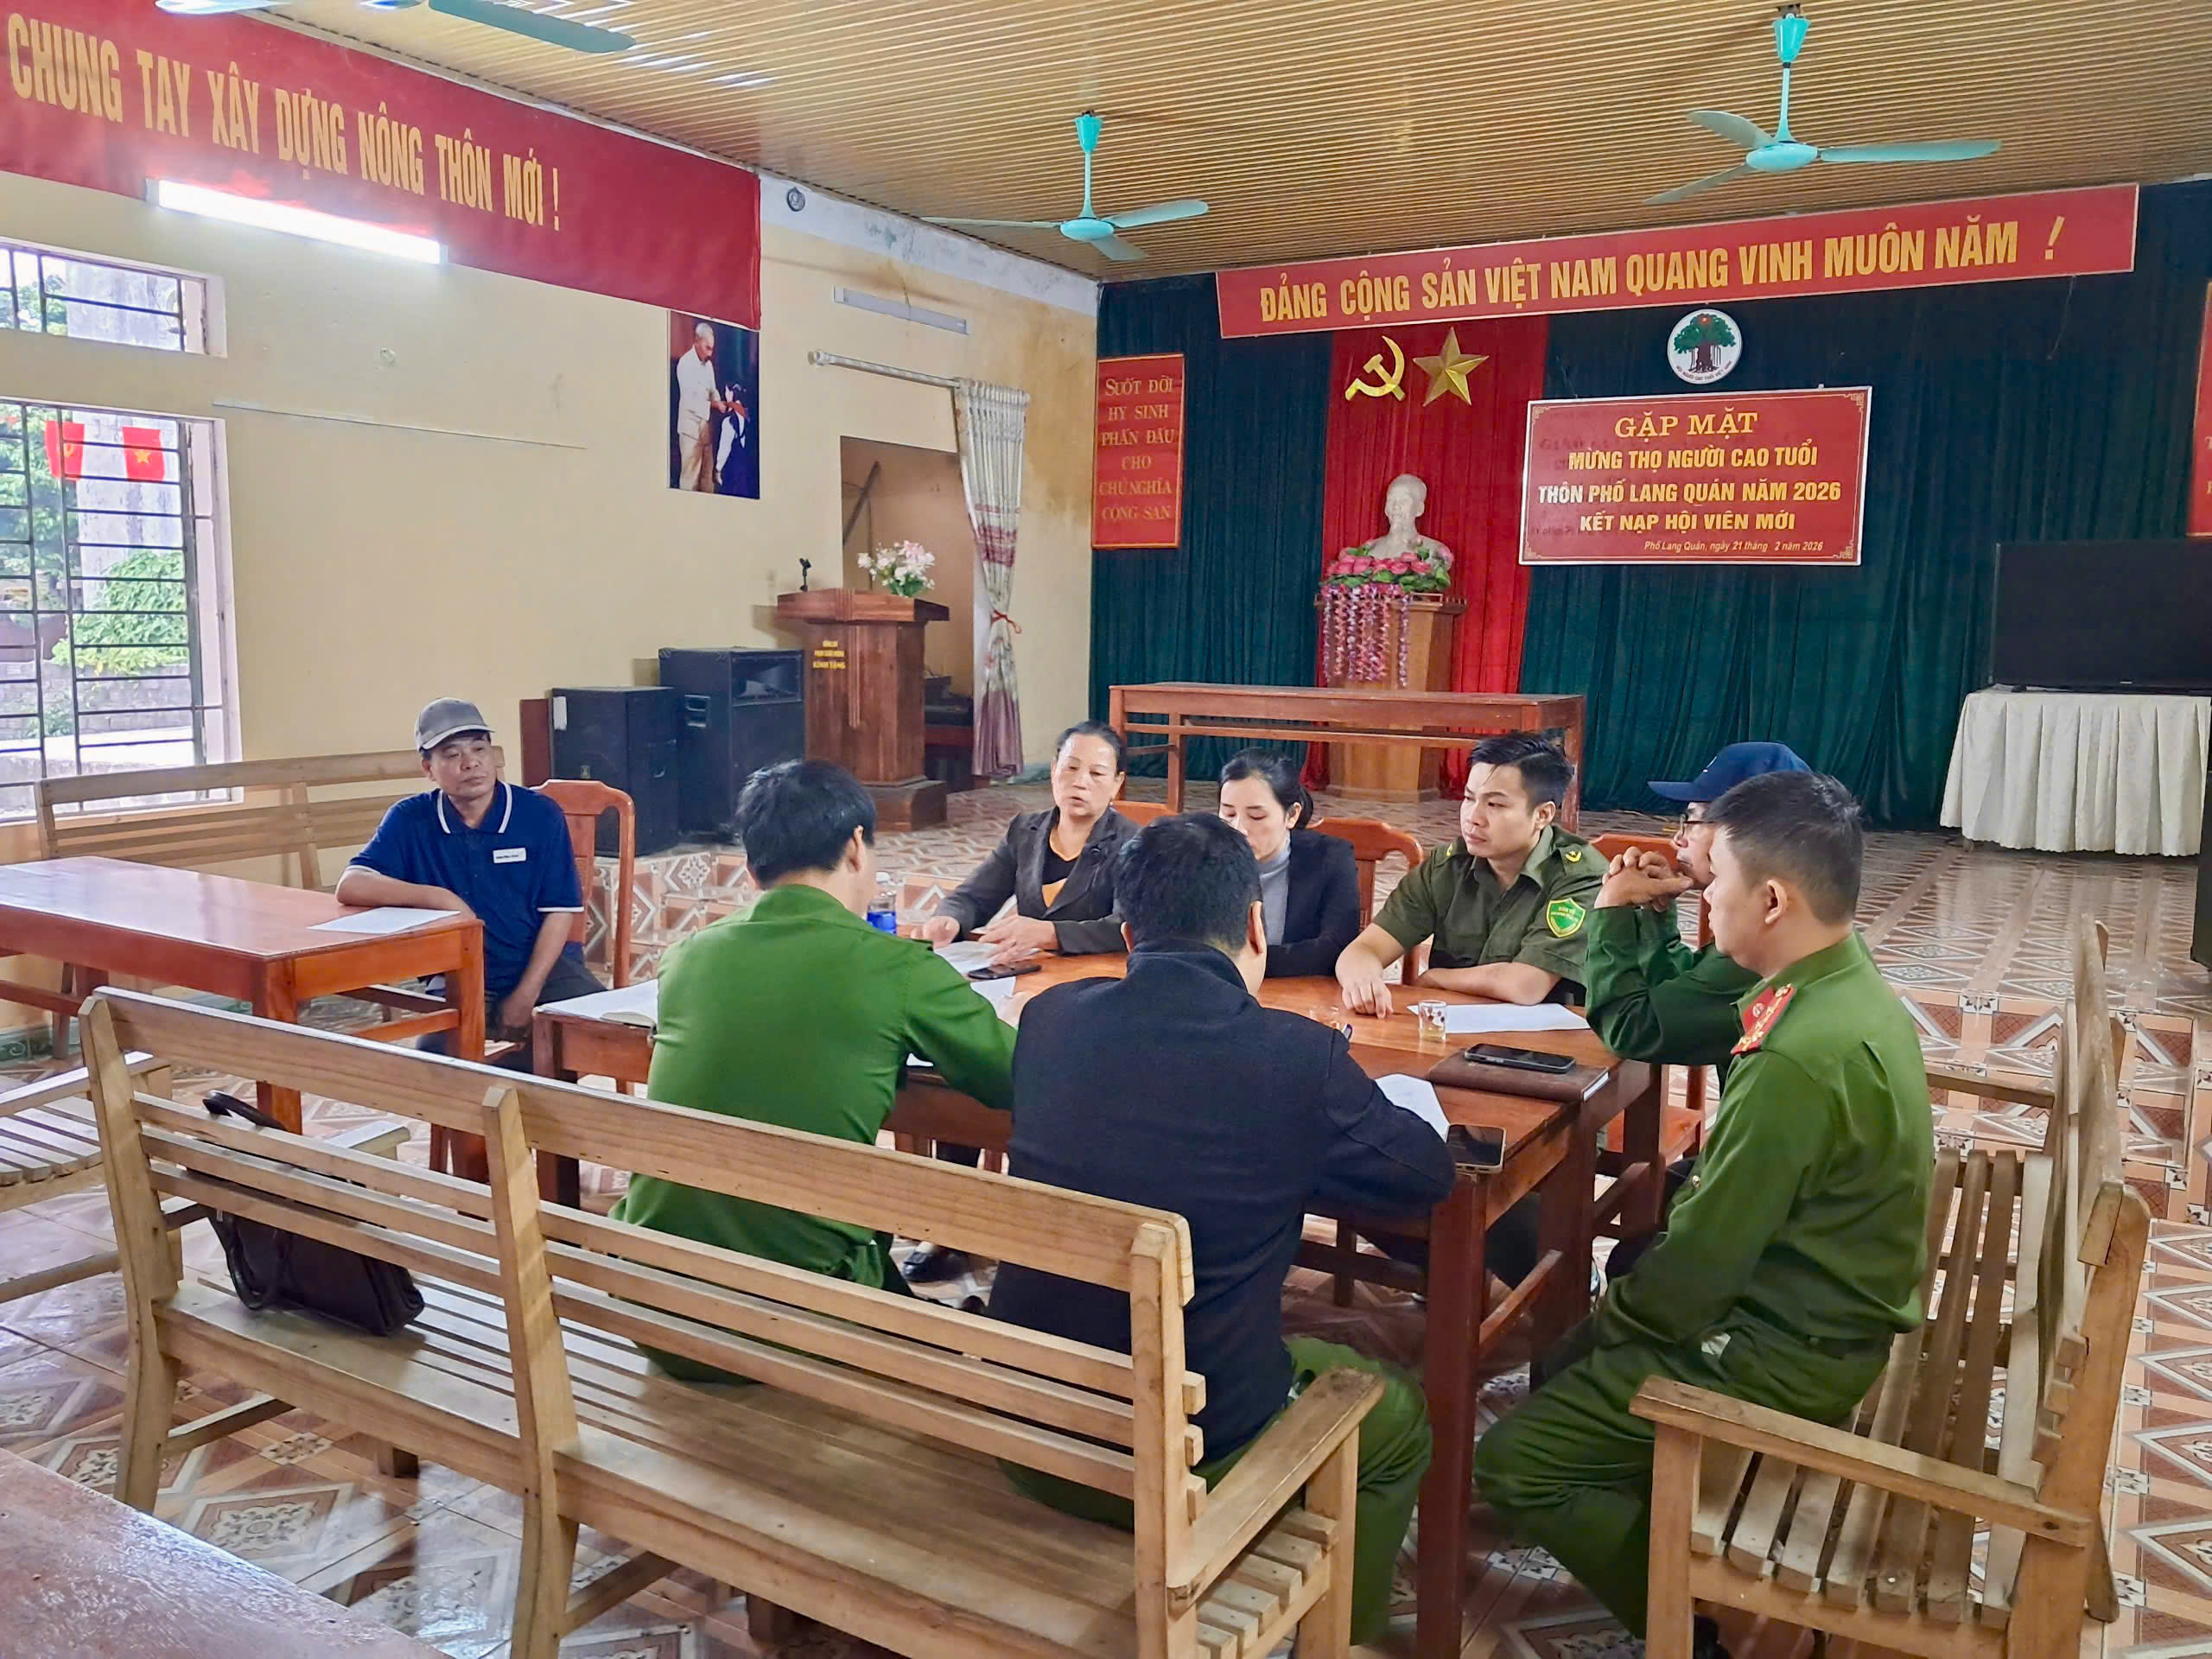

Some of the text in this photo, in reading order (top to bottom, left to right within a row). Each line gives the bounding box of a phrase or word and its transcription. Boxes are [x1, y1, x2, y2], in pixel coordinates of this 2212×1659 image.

[8, 13, 559, 231] CHUNG TAY XÂY DỰNG NÔNG THÔN MỚI !
[1260, 214, 2065, 322] ĐẢNG CỘNG SẢN VIỆT NAM QUANG VINH MUÔN NĂM !
[1108, 404, 1168, 422] HY SINH
[1614, 406, 1758, 443] GẶP MẶT
[1122, 455, 1152, 471] CHO
[1568, 438, 1818, 474] MỪNG THỌ NGƯỜI CAO TUỔI
[1538, 478, 1841, 504] THÔN PHỐ LANG QUÁN NĂM 2026
[1580, 510, 1615, 531] KẾT
[1619, 514, 1659, 534] NẠP
[1665, 510, 1698, 534] HỘI
[1704, 510, 1749, 530] VIÊN
[1755, 509, 1796, 530] MỚI
[1644, 540, 1661, 550] Phố
[1662, 541, 1682, 553] Lang
[1709, 540, 1730, 553] ngày
[1732, 540, 1743, 550] 21
[1744, 540, 1769, 553] tháng
[1774, 541, 1781, 551] 2
[1802, 541, 1823, 551] 2026
